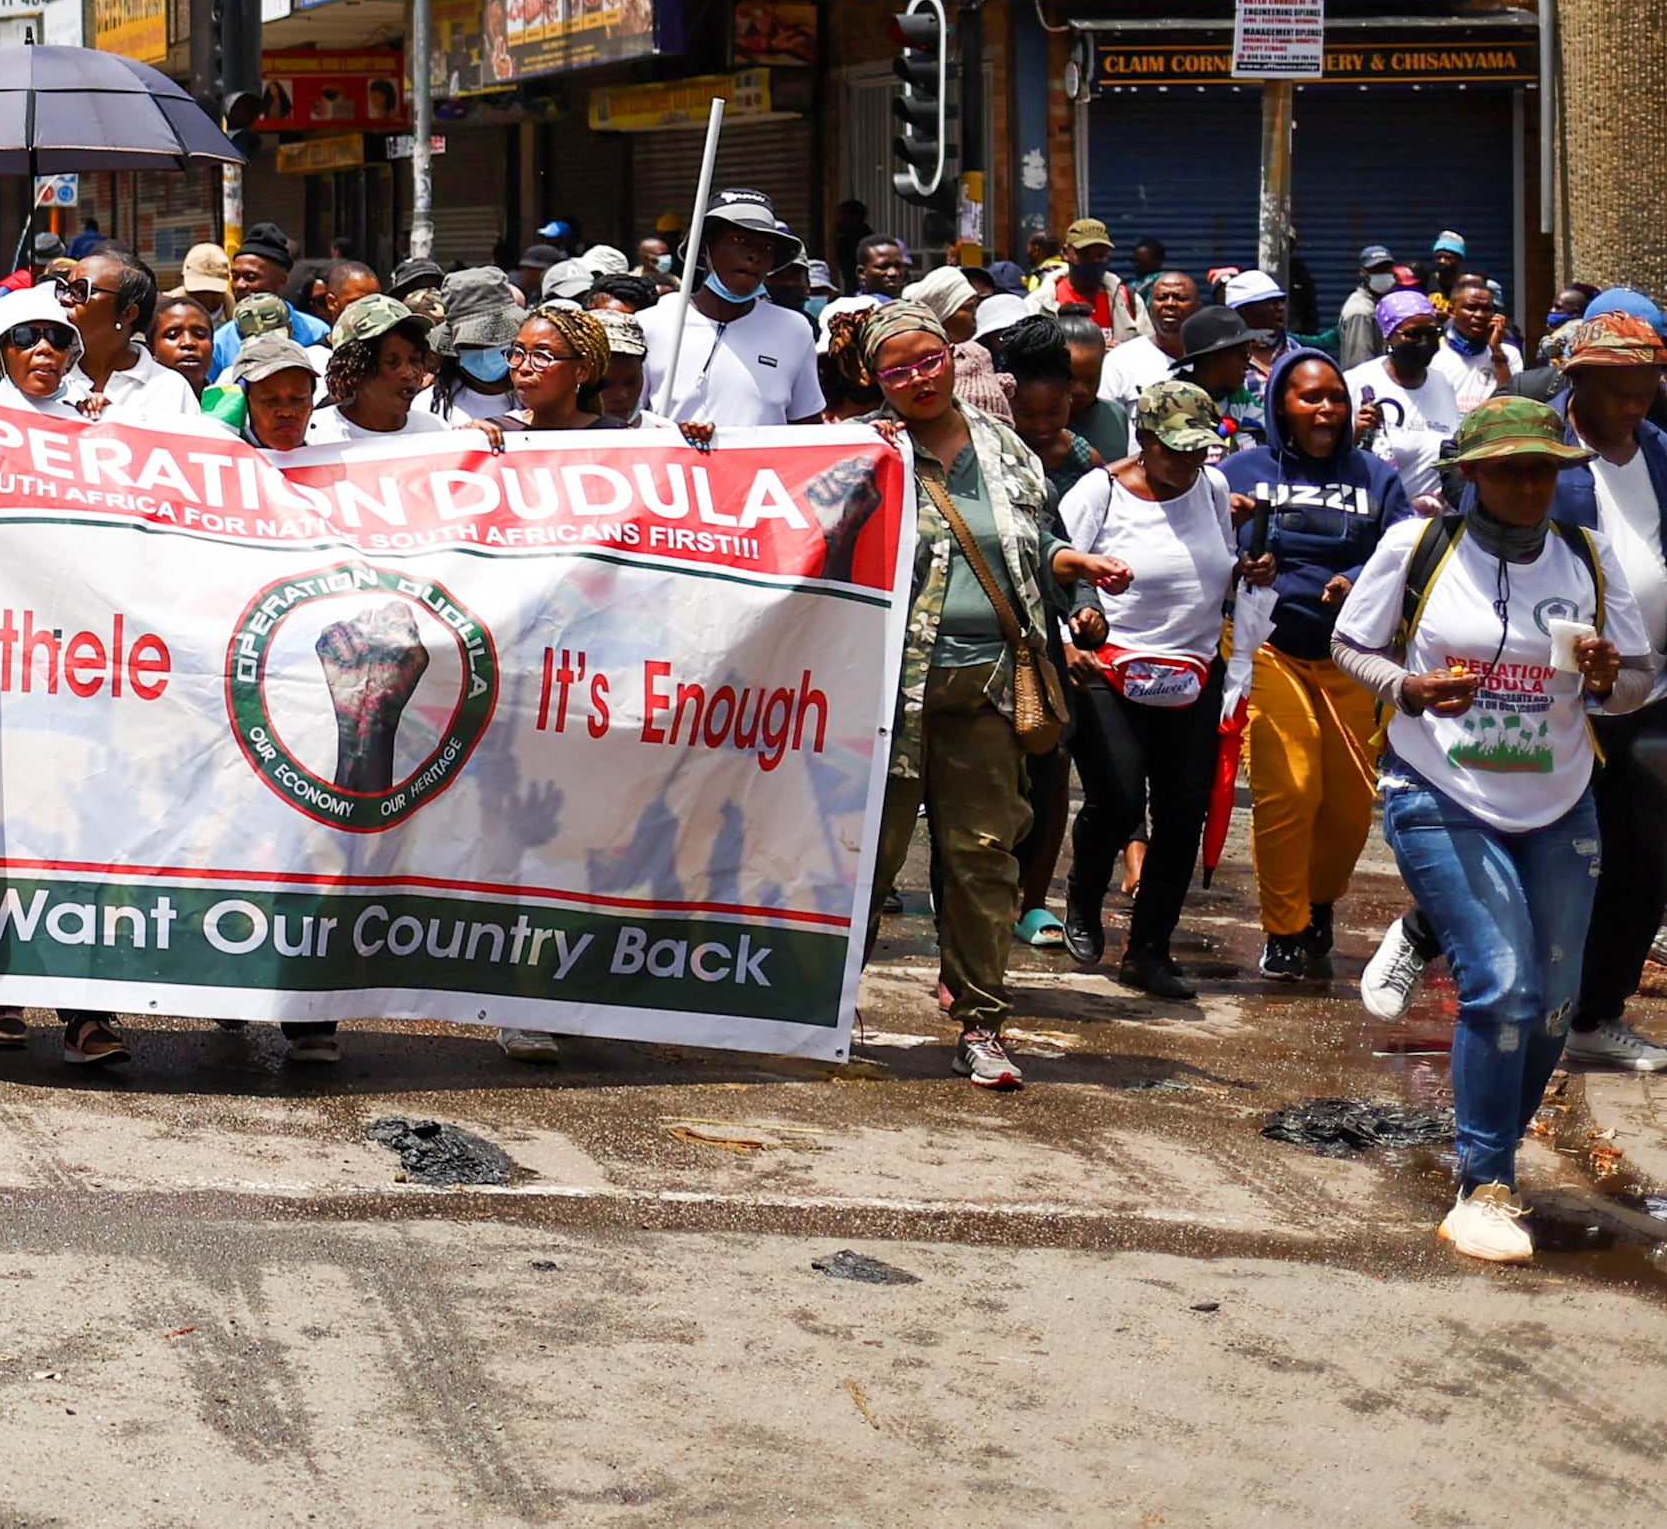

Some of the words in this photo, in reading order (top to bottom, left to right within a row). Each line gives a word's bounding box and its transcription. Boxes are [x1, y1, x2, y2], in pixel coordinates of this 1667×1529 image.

[1243, 8, 1293, 16] ENGINEERING
[1243, 28, 1294, 36] MANAGEMENT
[1104, 55, 1164, 73] CLAIM
[1370, 54, 1384, 70] &
[1391, 51, 1517, 71] CHISANYAMA
[63, 483, 178, 528] AFRICA
[184, 506, 246, 538] FOR
[370, 528, 476, 551] SOUTH
[484, 522, 641, 555] AFRICANS
[648, 529, 762, 562] FIRST!!!
[415, 465, 809, 531] DUDULA
[234, 565, 379, 686] OPERATION
[397, 574, 489, 700] DUDULA
[539, 646, 611, 741] It's
[642, 659, 831, 772] Enough
[247, 725, 278, 770] OUR
[272, 763, 356, 819] ECONOMY
[377, 793, 409, 819] OUR
[407, 735, 465, 809] HERITAGE
[202, 898, 341, 960] Our
[351, 901, 593, 981] Country
[612, 928, 773, 989] Back
